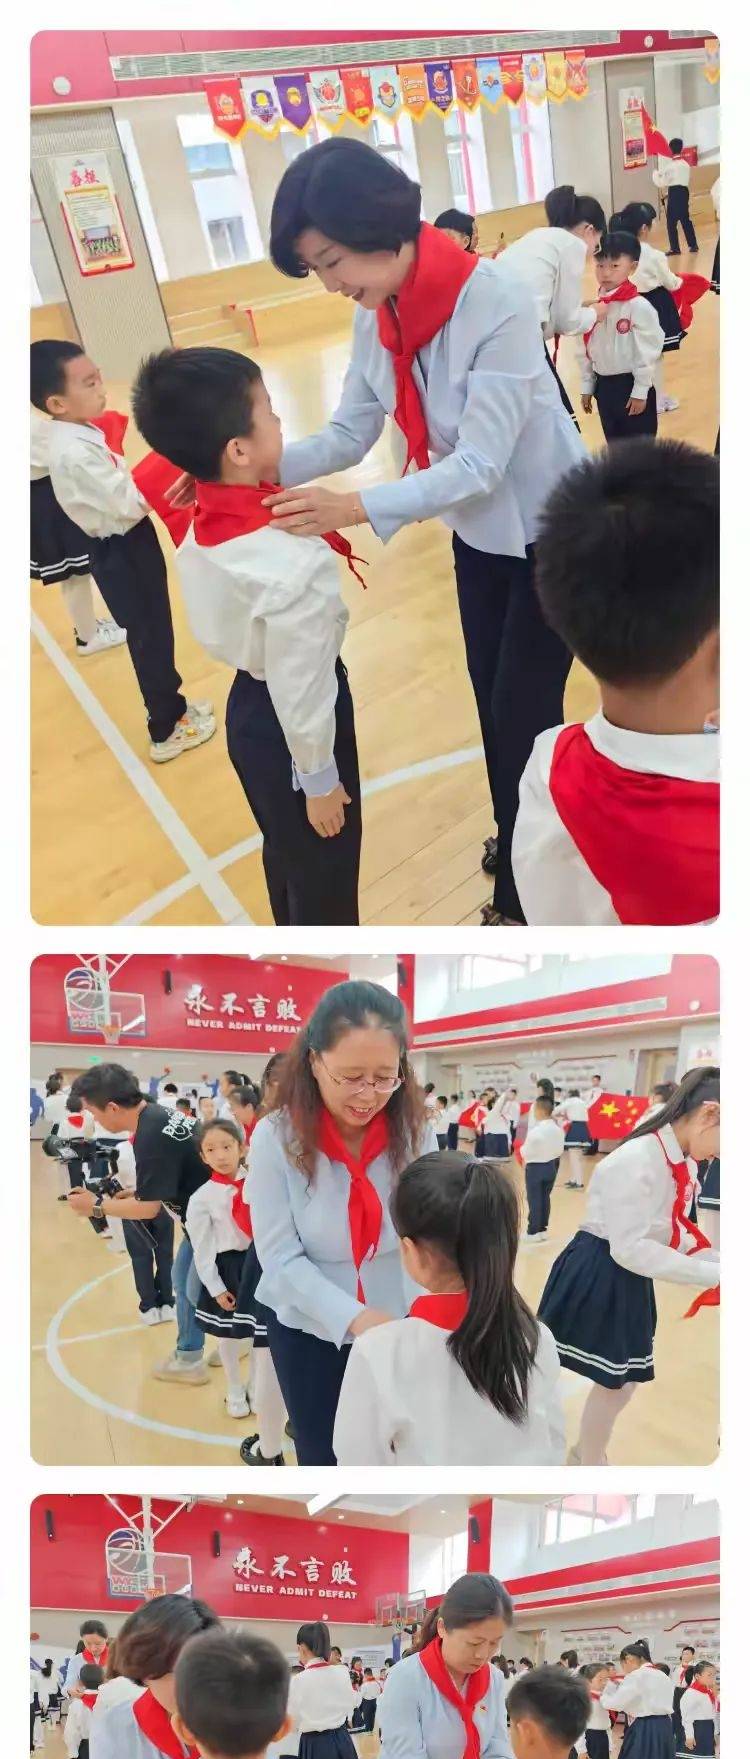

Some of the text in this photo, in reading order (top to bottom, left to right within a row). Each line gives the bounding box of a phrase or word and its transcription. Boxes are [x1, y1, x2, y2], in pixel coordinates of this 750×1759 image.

[184, 984, 302, 1021] 永不言败
[187, 1018, 224, 1029] NEVER
[228, 1022, 261, 1031] ADMIT
[232, 1546, 357, 1586] 永不言败
[235, 1583, 357, 1600] NEVER ADMIT DEFEAT
